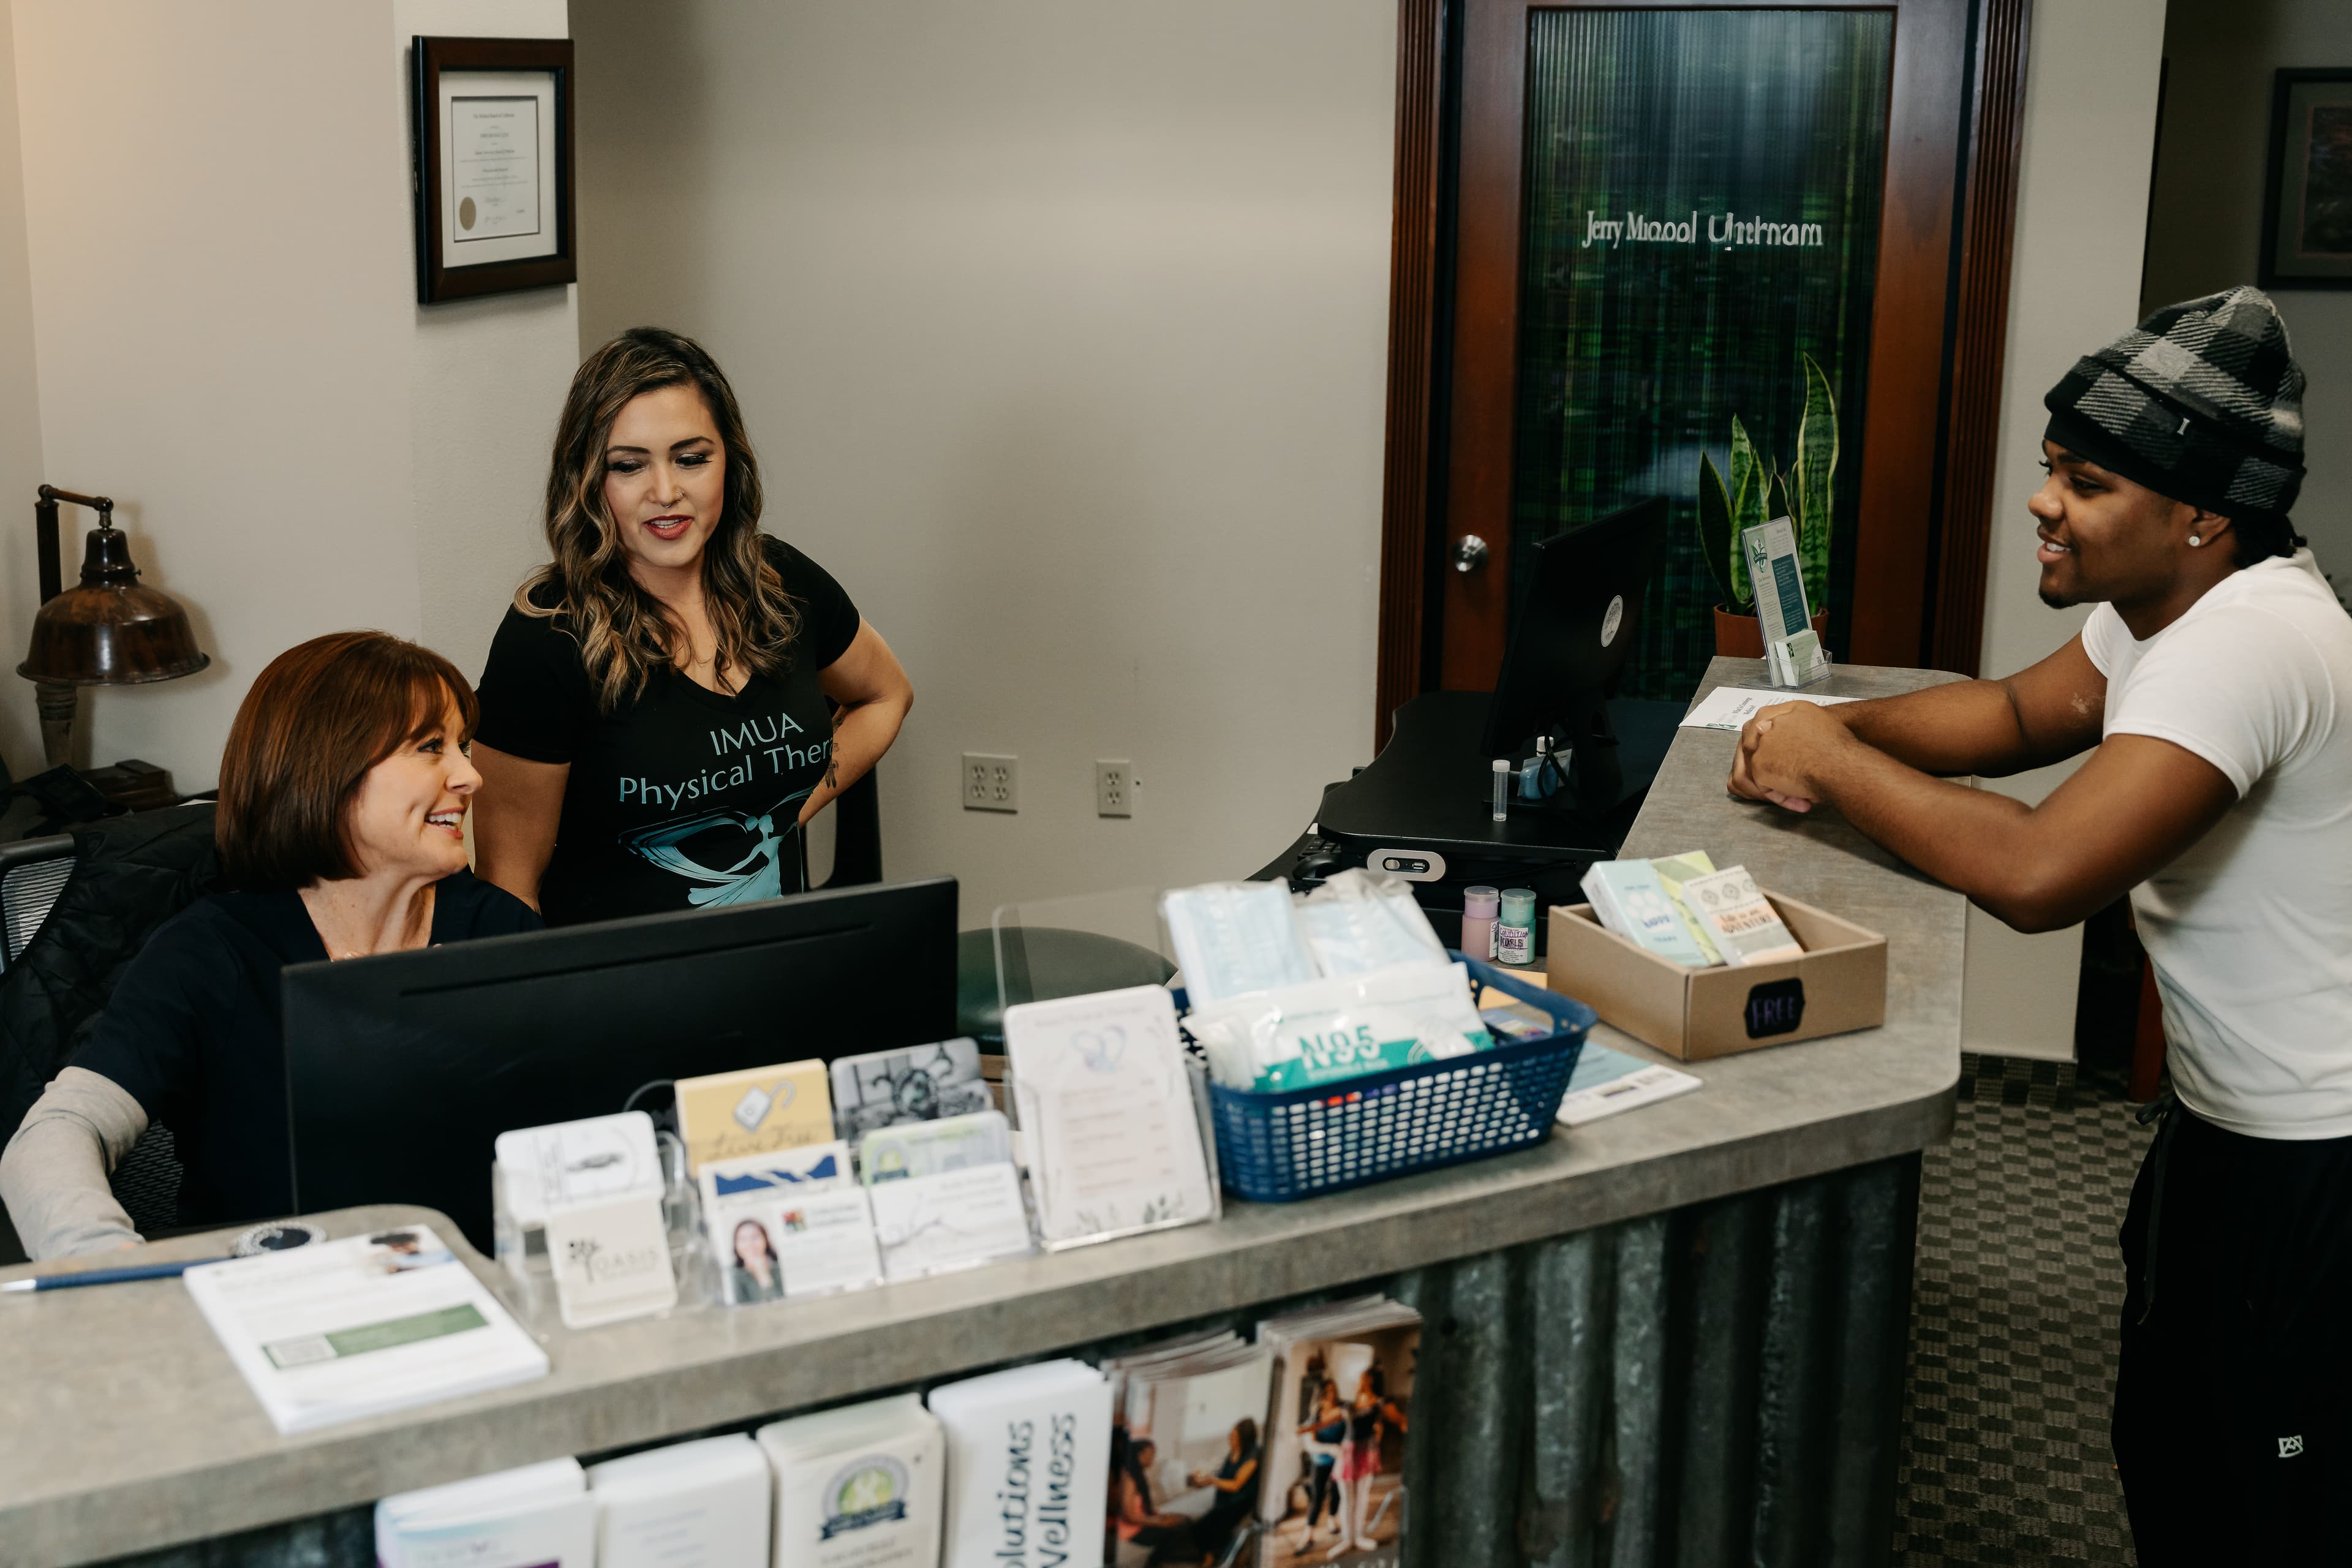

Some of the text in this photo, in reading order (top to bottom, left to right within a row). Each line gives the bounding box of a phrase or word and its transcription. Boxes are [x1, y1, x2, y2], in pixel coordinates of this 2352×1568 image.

[1581, 210, 1624, 249] Jerry
[710, 713, 804, 755] IMUA
[619, 755, 753, 810] Physical
[1752, 996, 1795, 1029] FREE
[1298, 1023, 1381, 1070] N95
